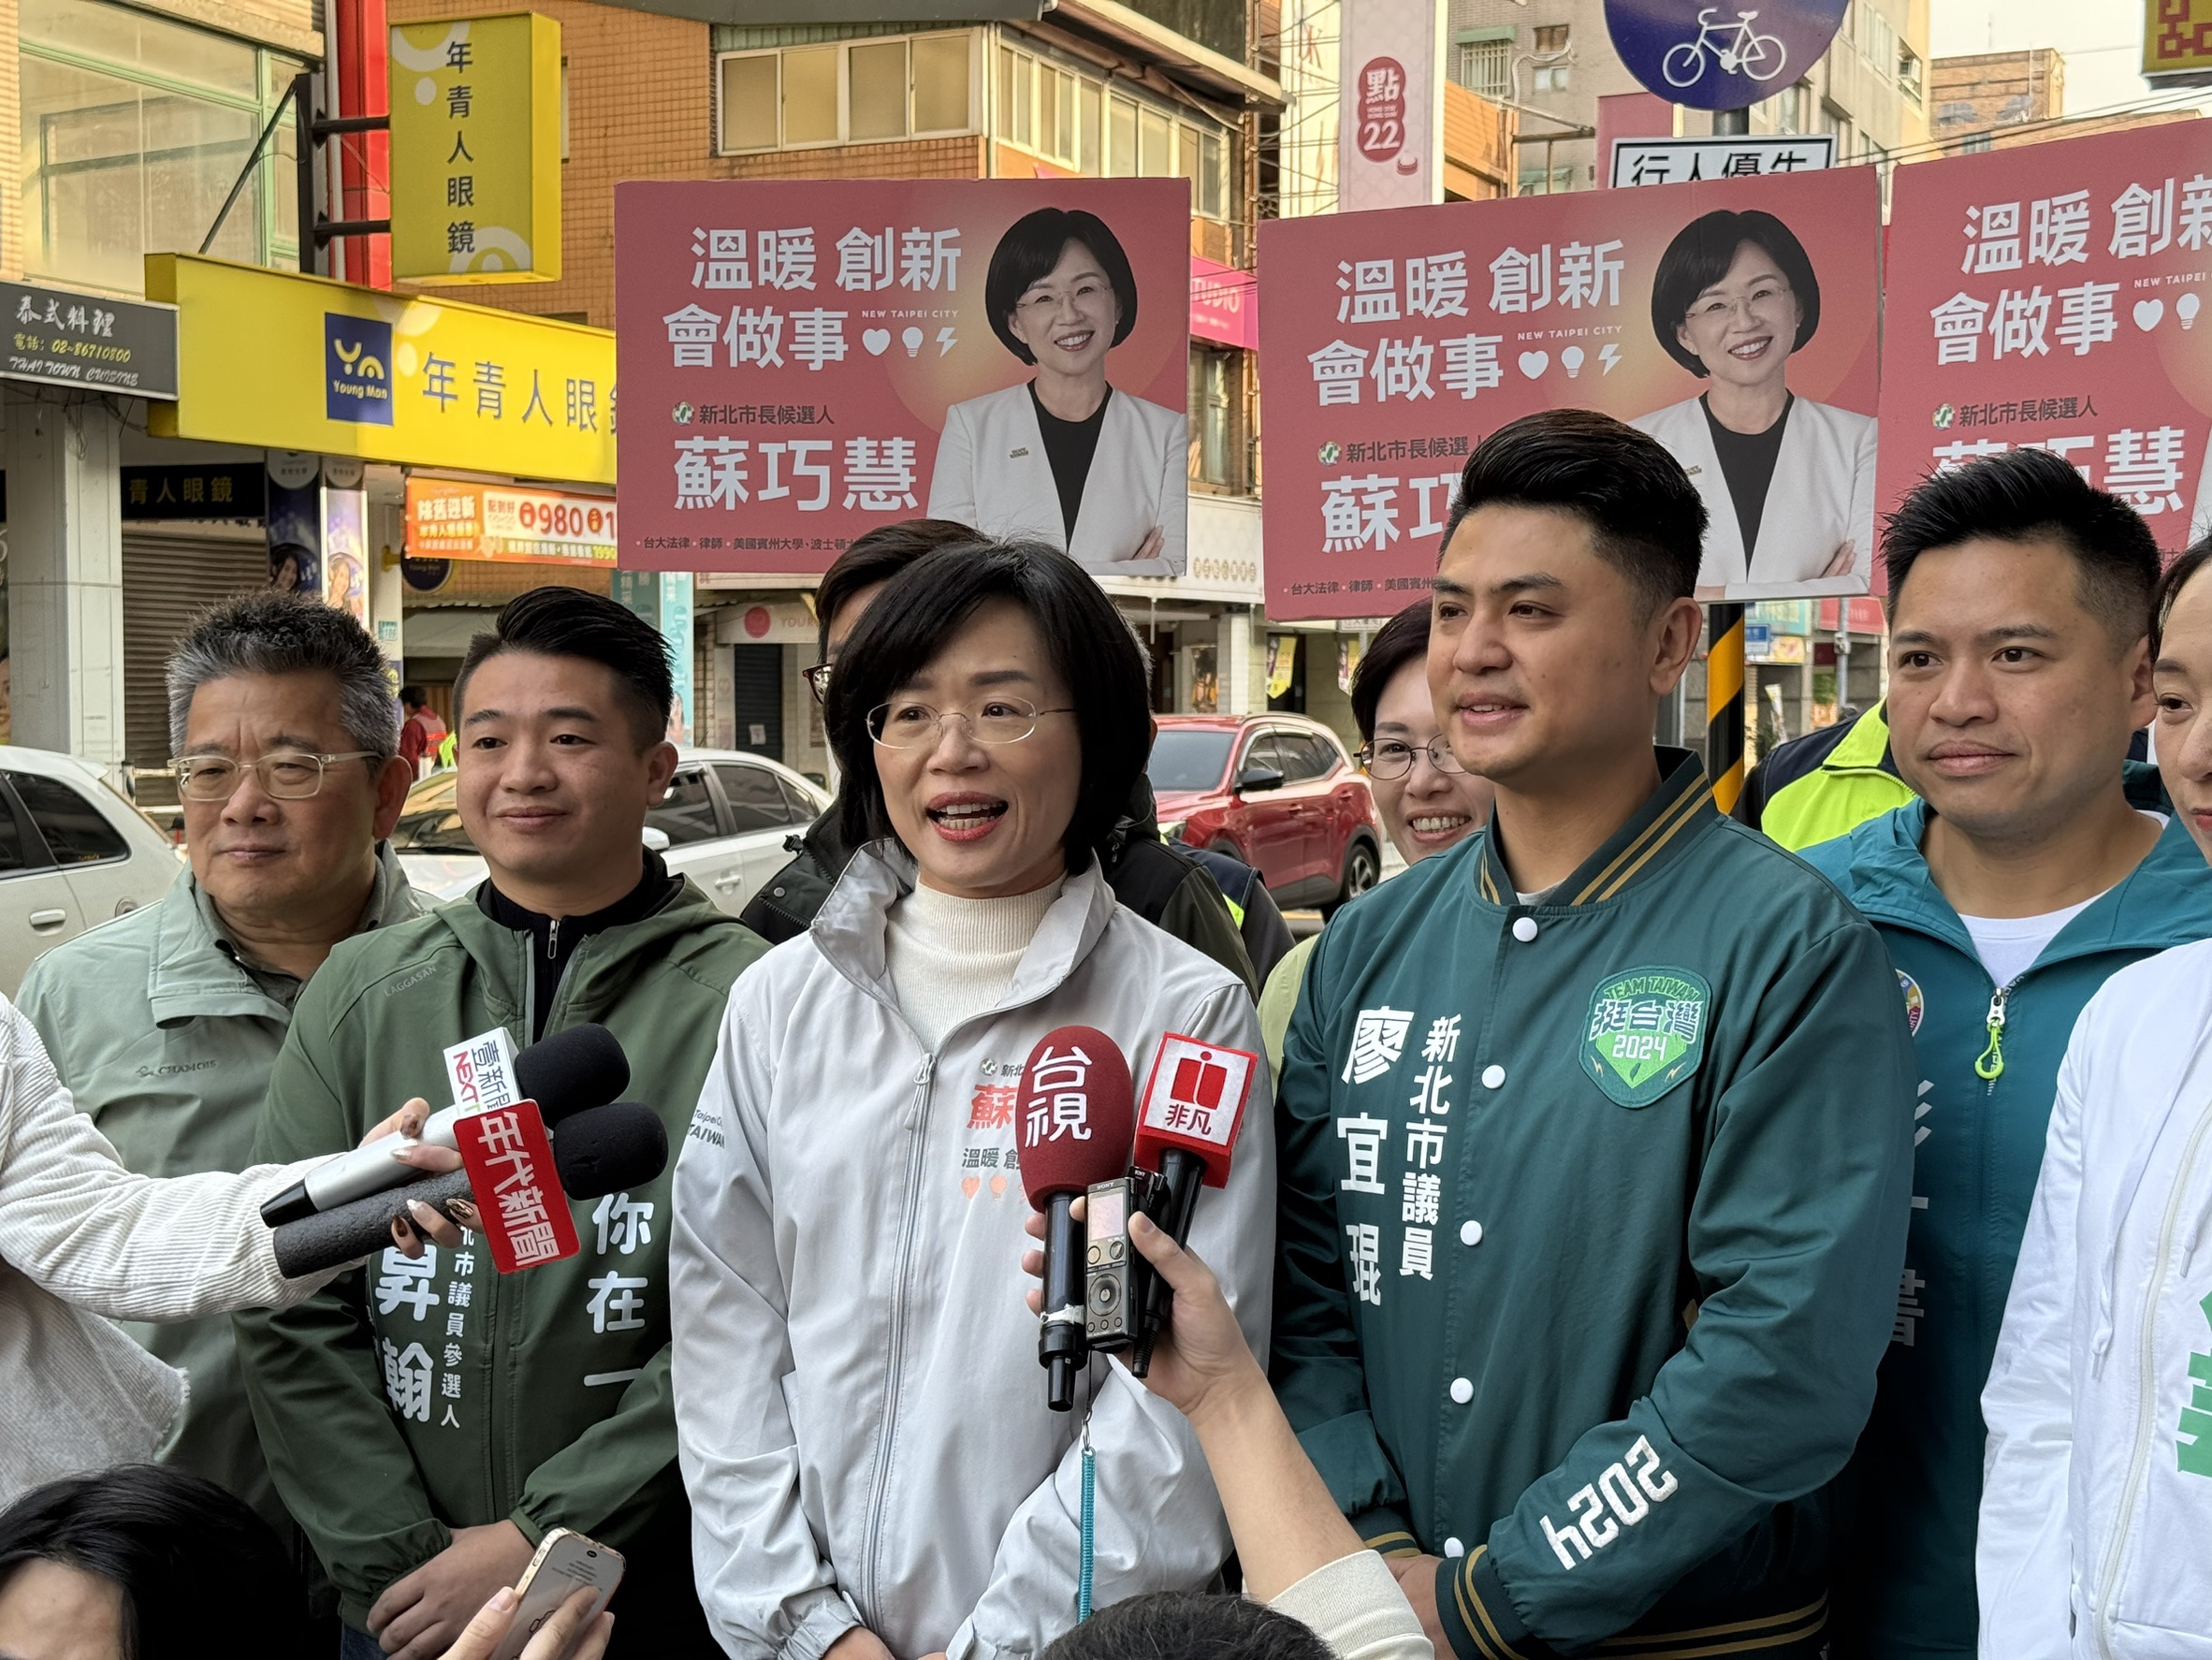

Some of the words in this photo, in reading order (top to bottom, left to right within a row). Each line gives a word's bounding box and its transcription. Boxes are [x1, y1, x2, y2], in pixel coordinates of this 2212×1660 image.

[1365, 67, 1400, 105] 點
[445, 40, 475, 255] 年青人眼鏡
[1363, 121, 1400, 151] 22
[1961, 189, 2090, 275] 溫暖
[691, 226, 817, 292] 溫暖
[835, 226, 962, 293] 創新
[1335, 249, 1469, 325] 溫暖
[1488, 239, 1625, 315] 創新
[2133, 277, 2161, 289] NEW
[2165, 272, 2206, 284] TAIPEI
[16, 295, 115, 338] 泰式料理
[862, 310, 886, 319] NEW
[891, 310, 927, 319] TAIPEI
[932, 310, 960, 319] CITY
[1929, 281, 2120, 366] 會做事
[662, 303, 850, 371] 會做事
[1517, 329, 1544, 342] NEW
[1549, 327, 1589, 340] TAIPEI
[1593, 324, 1623, 336] CITY
[8, 356, 44, 372] THAI
[1306, 333, 1505, 407] 會做事
[333, 380, 365, 400] Young
[366, 386, 388, 400] Man
[422, 352, 616, 436] 年青人眼
[699, 404, 835, 426] 新北市長候選人
[1959, 395, 2098, 428] 新北市長候選人
[129, 476, 233, 505] 青人眼鏡
[674, 436, 920, 513] 蘇巧慧
[538, 502, 584, 537] 980
[644, 536, 691, 549] 台大法律
[699, 537, 723, 549] 律師
[1291, 581, 1340, 596] 台大法律
[1348, 579, 1374, 593] 律師
[384, 965, 437, 997] LAGGASAN
[1603, 976, 1647, 1001] TEAM
[1648, 976, 1700, 1001] TAIWAN
[1589, 998, 1704, 1044] 挺台灣
[1612, 1035, 1667, 1062] 2024
[158, 1059, 218, 1075] CHAMOIS
[967, 1085, 1019, 1129] 蘇
[1025, 1046, 1093, 1148] 台視
[1165, 1104, 1212, 1135] 非凡
[962, 1147, 999, 1168] 溫暖
[1336, 1005, 1415, 1306] 廖宜琨
[1399, 1013, 1462, 1281] 新北市議員
[477, 1111, 561, 1267] 年代新聞
[584, 1192, 654, 1387] 你在一
